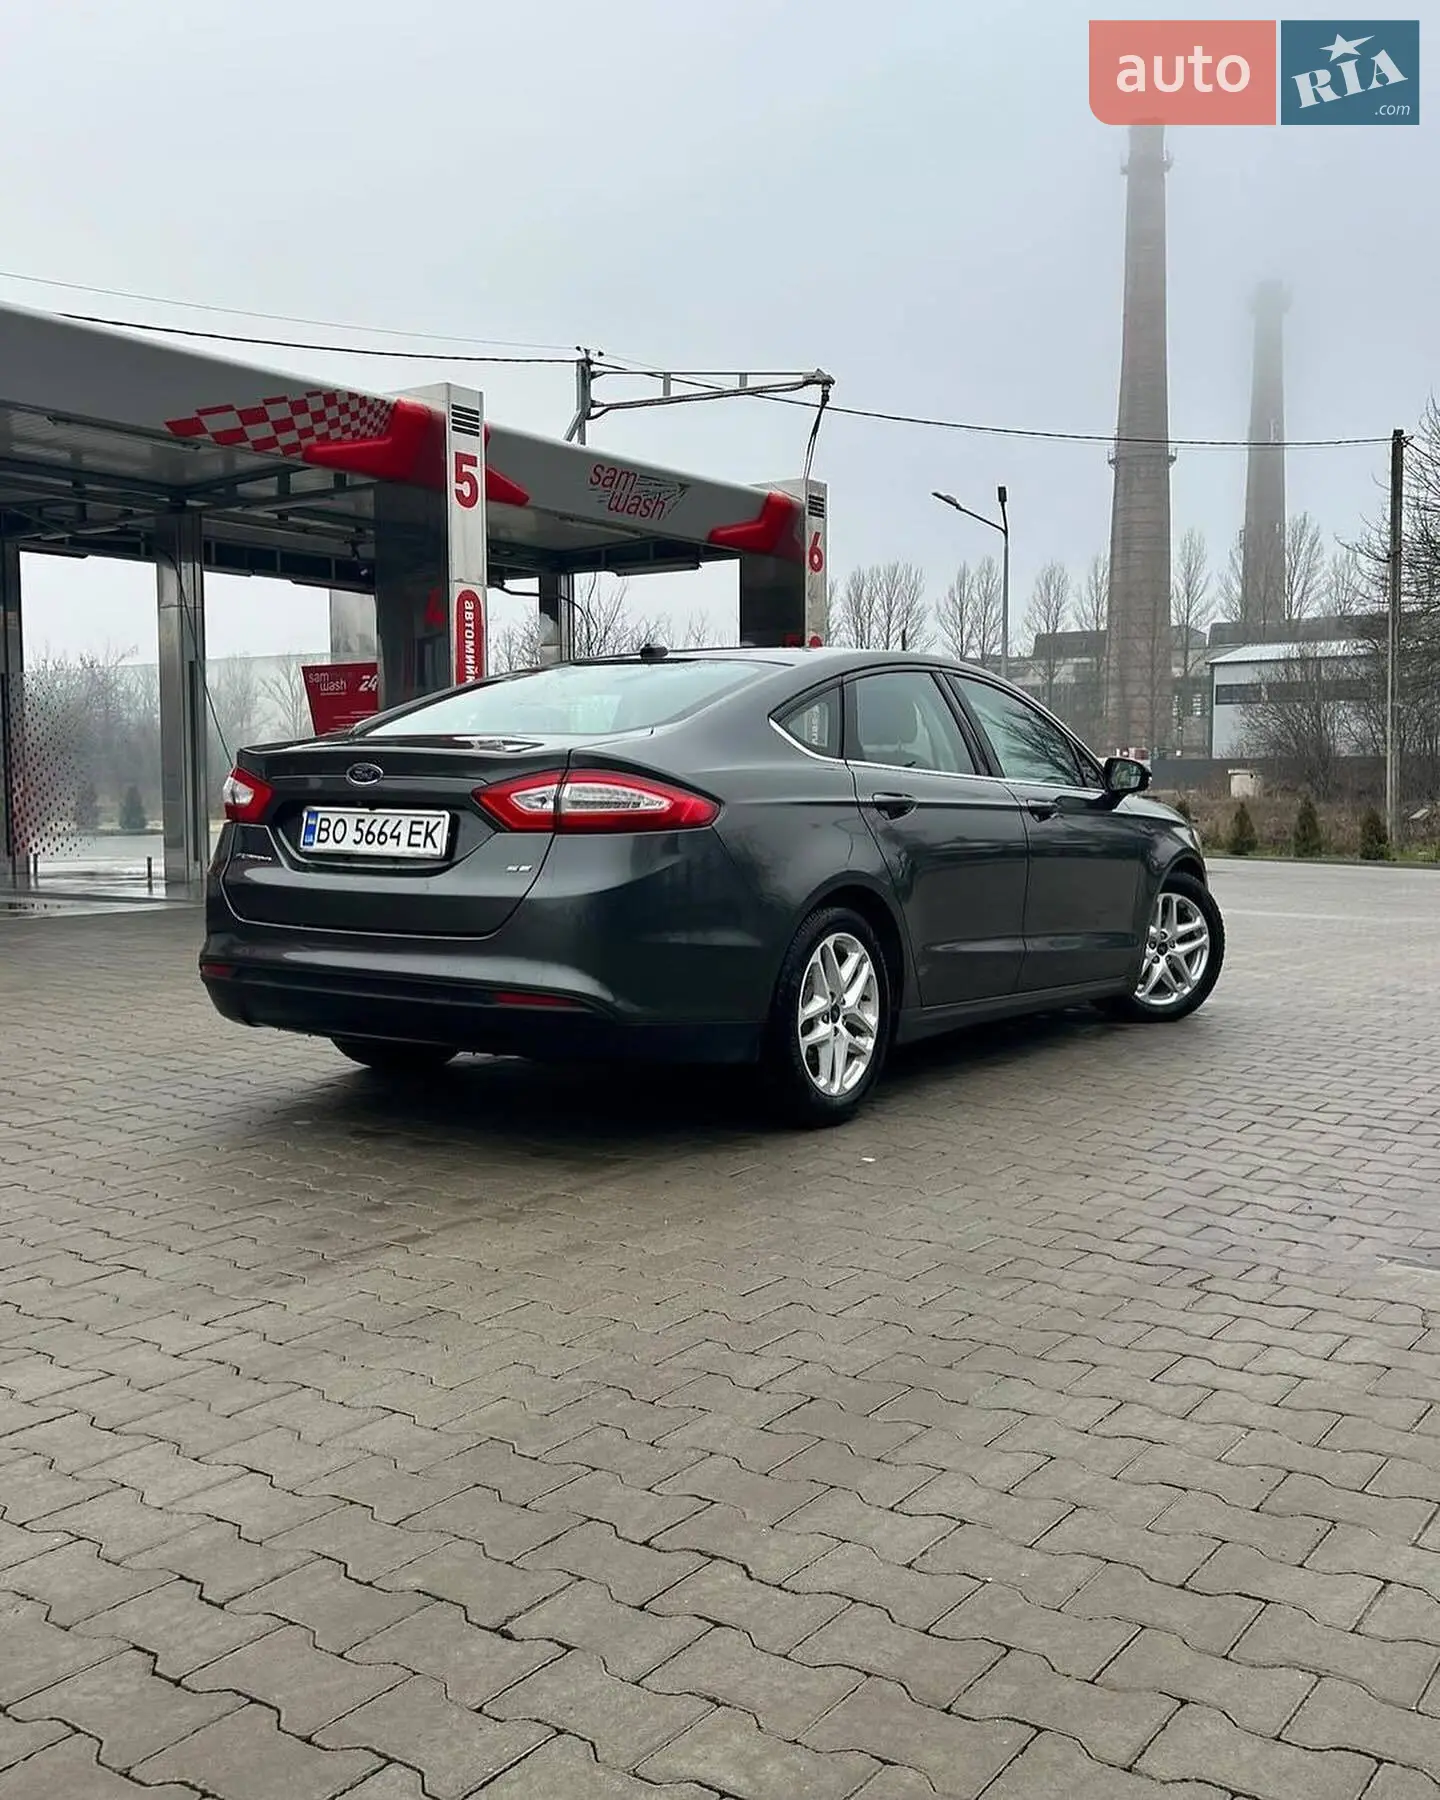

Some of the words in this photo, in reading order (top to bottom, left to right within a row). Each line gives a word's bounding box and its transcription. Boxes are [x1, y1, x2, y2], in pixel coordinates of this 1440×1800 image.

[454, 451, 479, 509] 5
[589, 463, 638, 491] sam
[608, 490, 666, 521] wash
[808, 531, 824, 573] 6
[308, 672, 330, 684] sam
[319, 677, 347, 692] wash
[316, 817, 348, 844] BO
[352, 818, 403, 846] 5664
[407, 820, 441, 848] EK
